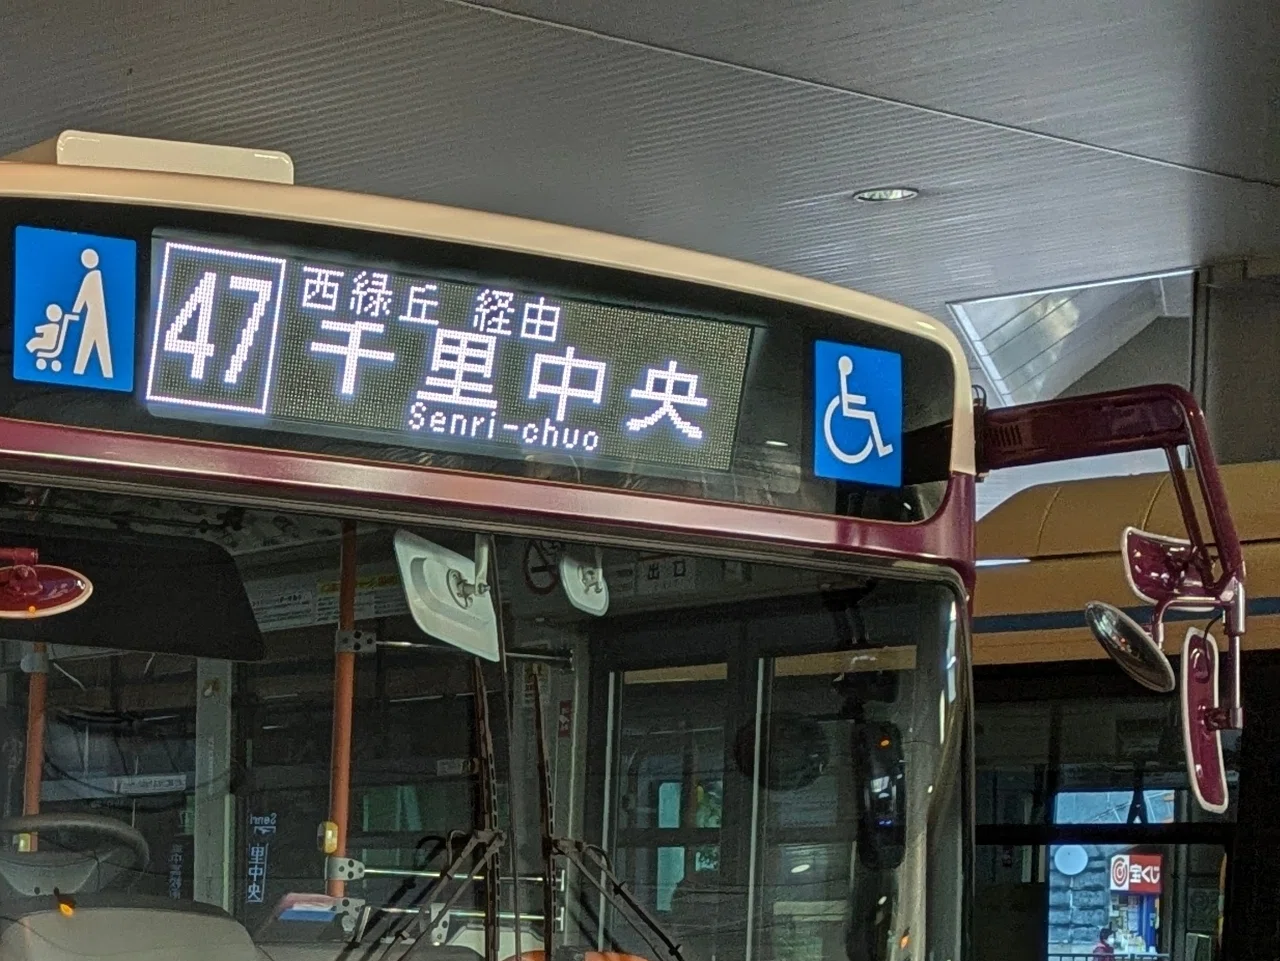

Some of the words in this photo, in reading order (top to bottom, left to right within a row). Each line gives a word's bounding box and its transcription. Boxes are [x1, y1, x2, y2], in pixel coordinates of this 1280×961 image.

[164, 271, 273, 385] 47
[302, 265, 440, 326] 西緑丘
[473, 288, 561, 343] 経由
[310, 319, 709, 440] 千里中央
[409, 402, 599, 451] Senri-chuo
[1130, 864, 1161, 884] 宝くじ
